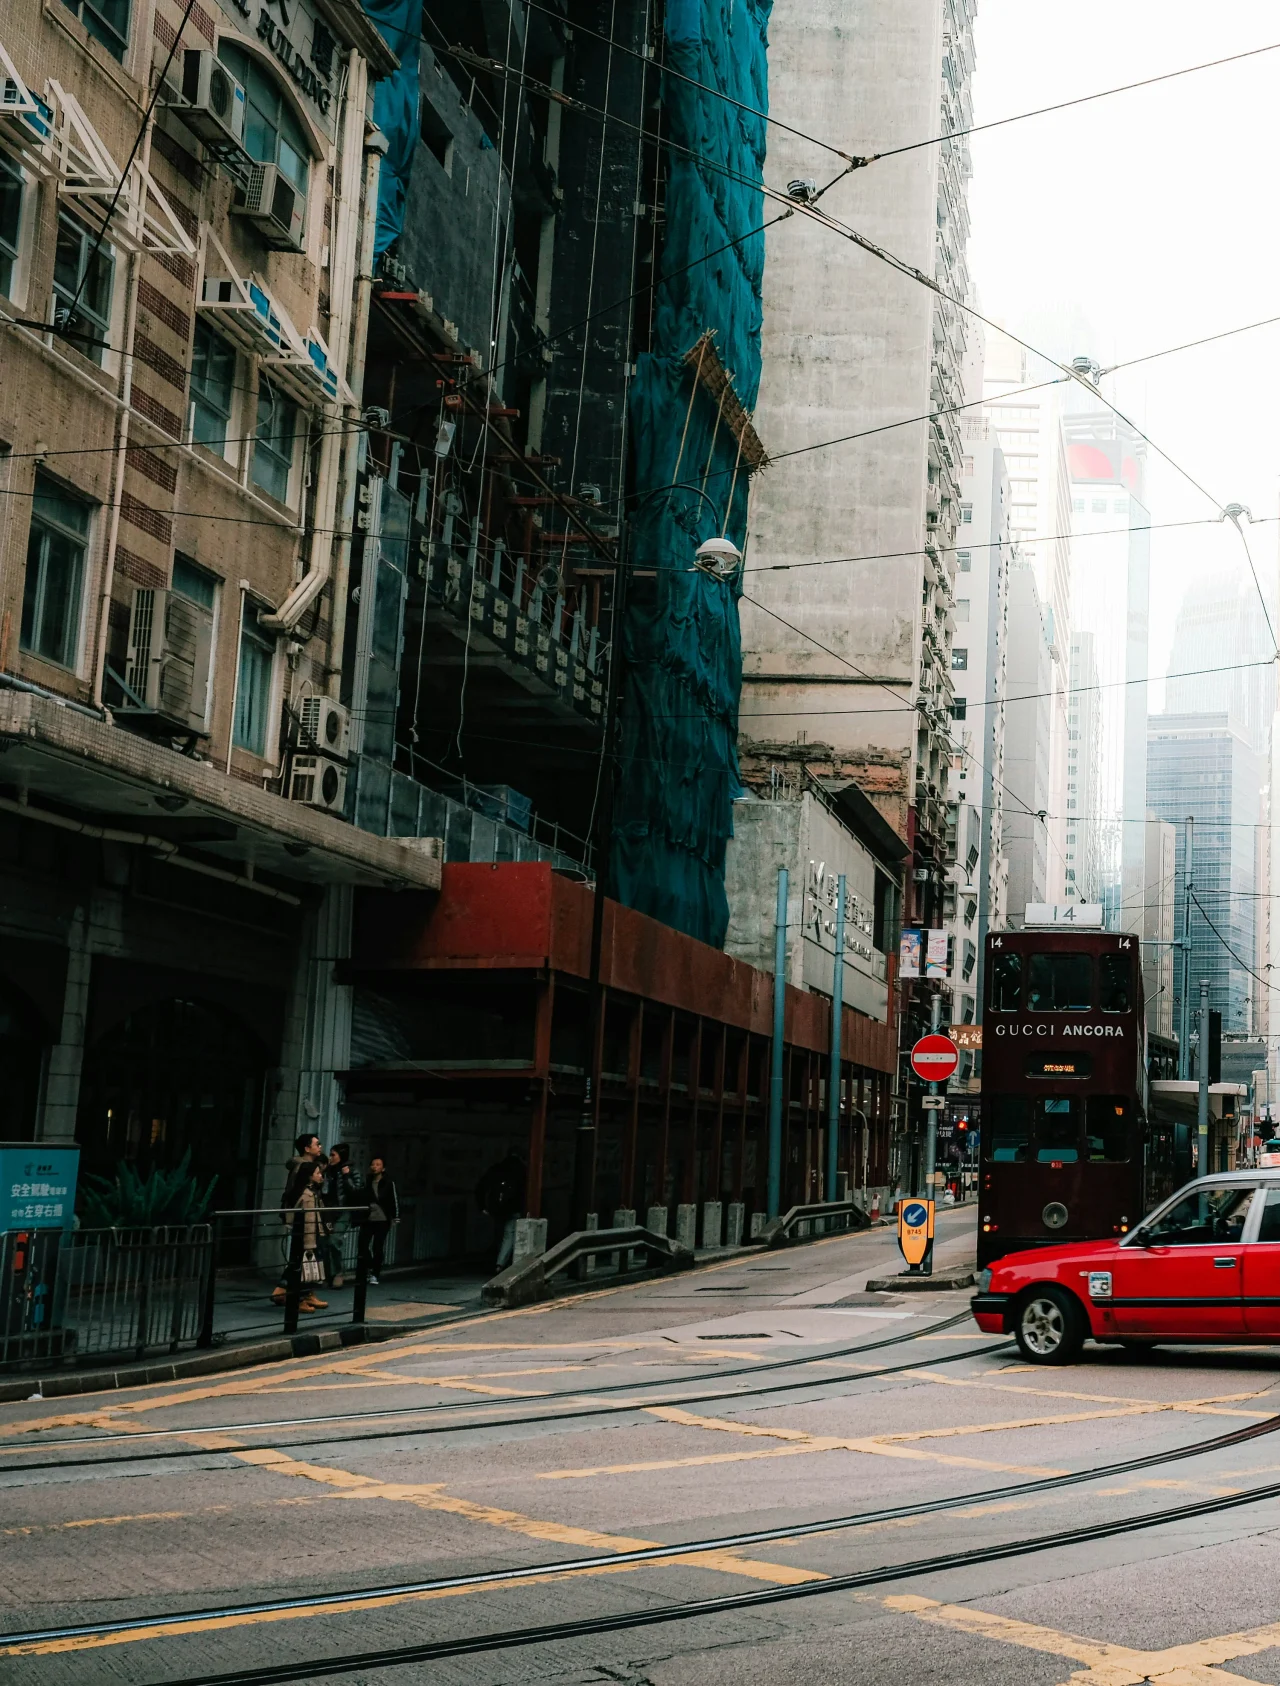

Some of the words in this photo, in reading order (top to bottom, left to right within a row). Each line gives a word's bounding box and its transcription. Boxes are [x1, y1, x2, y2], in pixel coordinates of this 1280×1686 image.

[256, 8, 331, 116] BUILDING
[1053, 906, 1077, 921] 14
[991, 937, 1003, 949] 14
[1119, 938, 1131, 950] 14
[996, 1024, 1055, 1036] GUCCI
[1062, 1025, 1124, 1037] ANCORA
